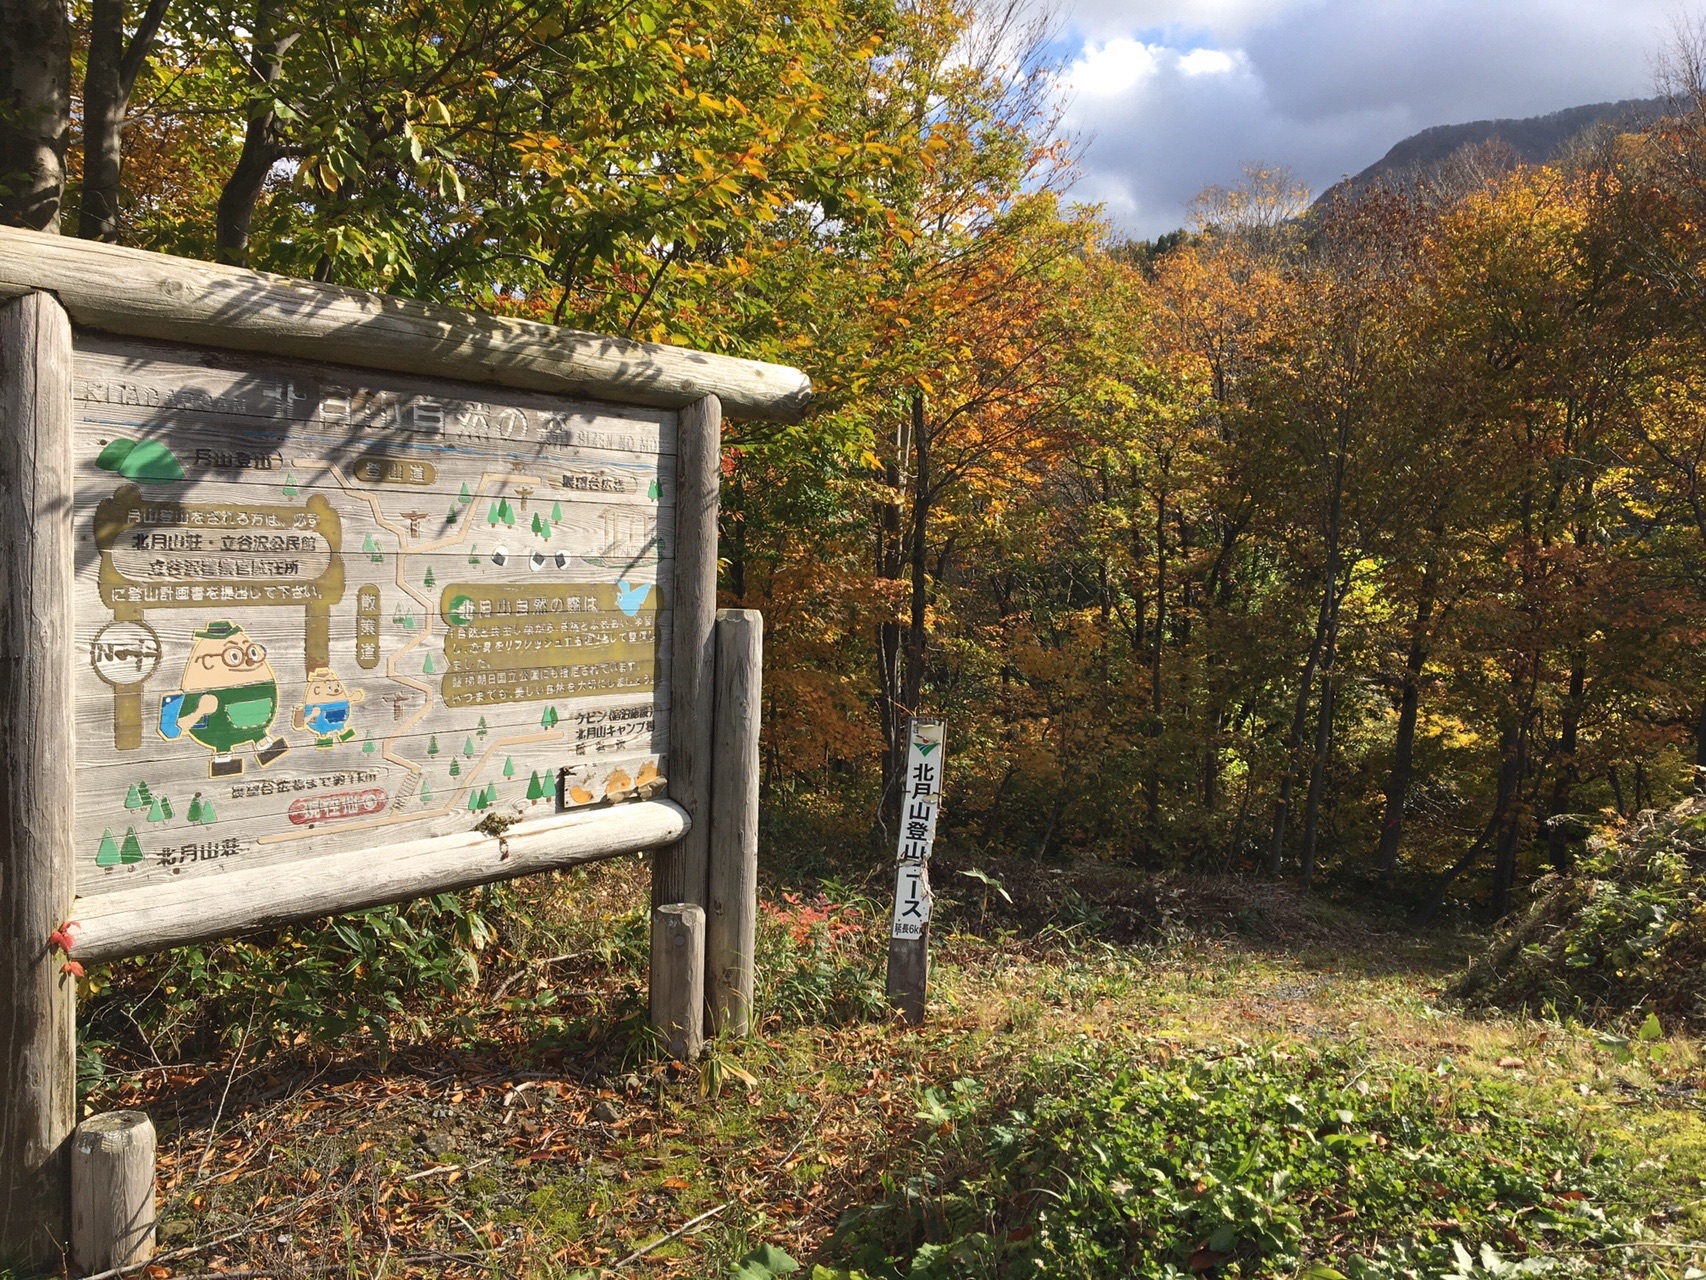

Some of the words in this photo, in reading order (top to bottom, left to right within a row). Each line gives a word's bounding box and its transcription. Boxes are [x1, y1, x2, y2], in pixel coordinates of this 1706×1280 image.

[365, 461, 425, 482] 登山道
[132, 532, 317, 552] 北月山荘・立谷沢公民館
[111, 585, 323, 602] に登山計画書を提出して下さい。
[360, 593, 376, 660] 散策道
[156, 837, 240, 867] 北月山荘
[894, 922, 921, 938] 延長6k
